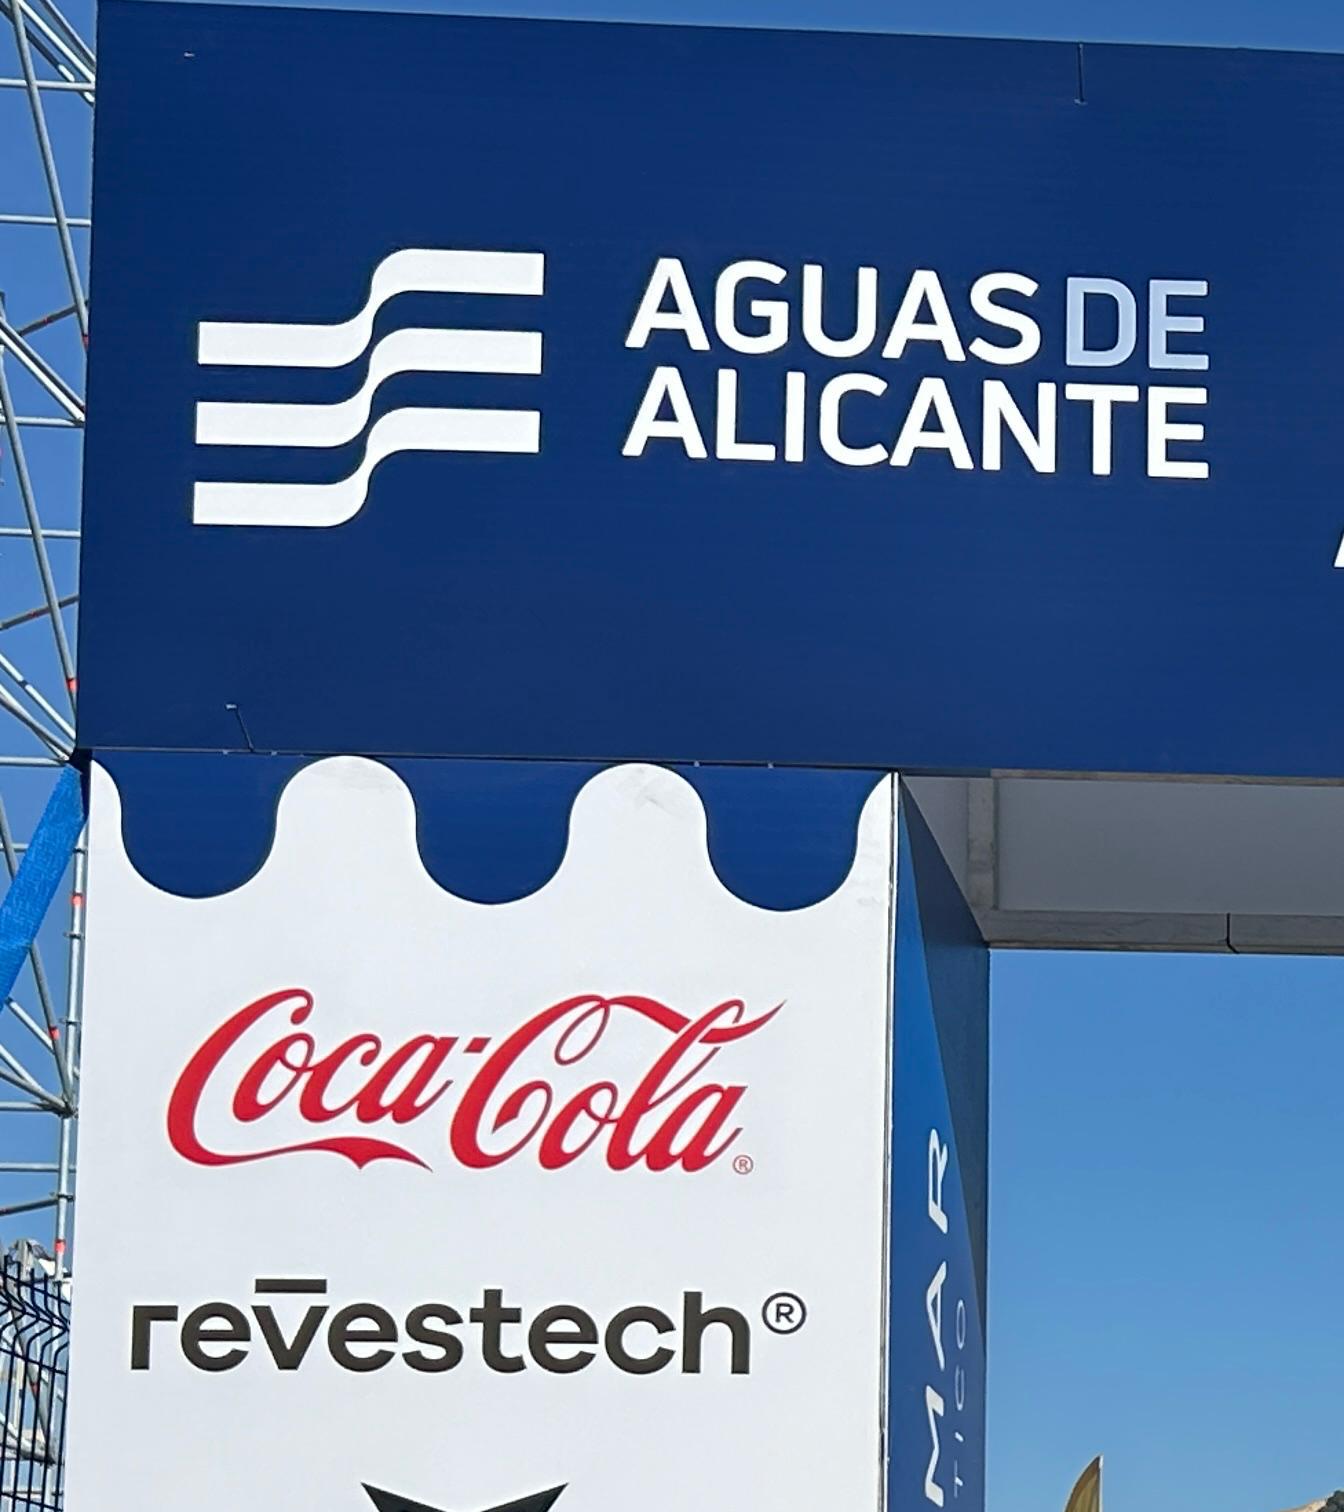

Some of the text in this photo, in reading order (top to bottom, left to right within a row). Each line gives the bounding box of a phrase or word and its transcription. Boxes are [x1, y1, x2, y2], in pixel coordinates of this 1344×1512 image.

[625, 257, 1210, 370] AGUAS DE
[621, 365, 1210, 479] ALICANTE
